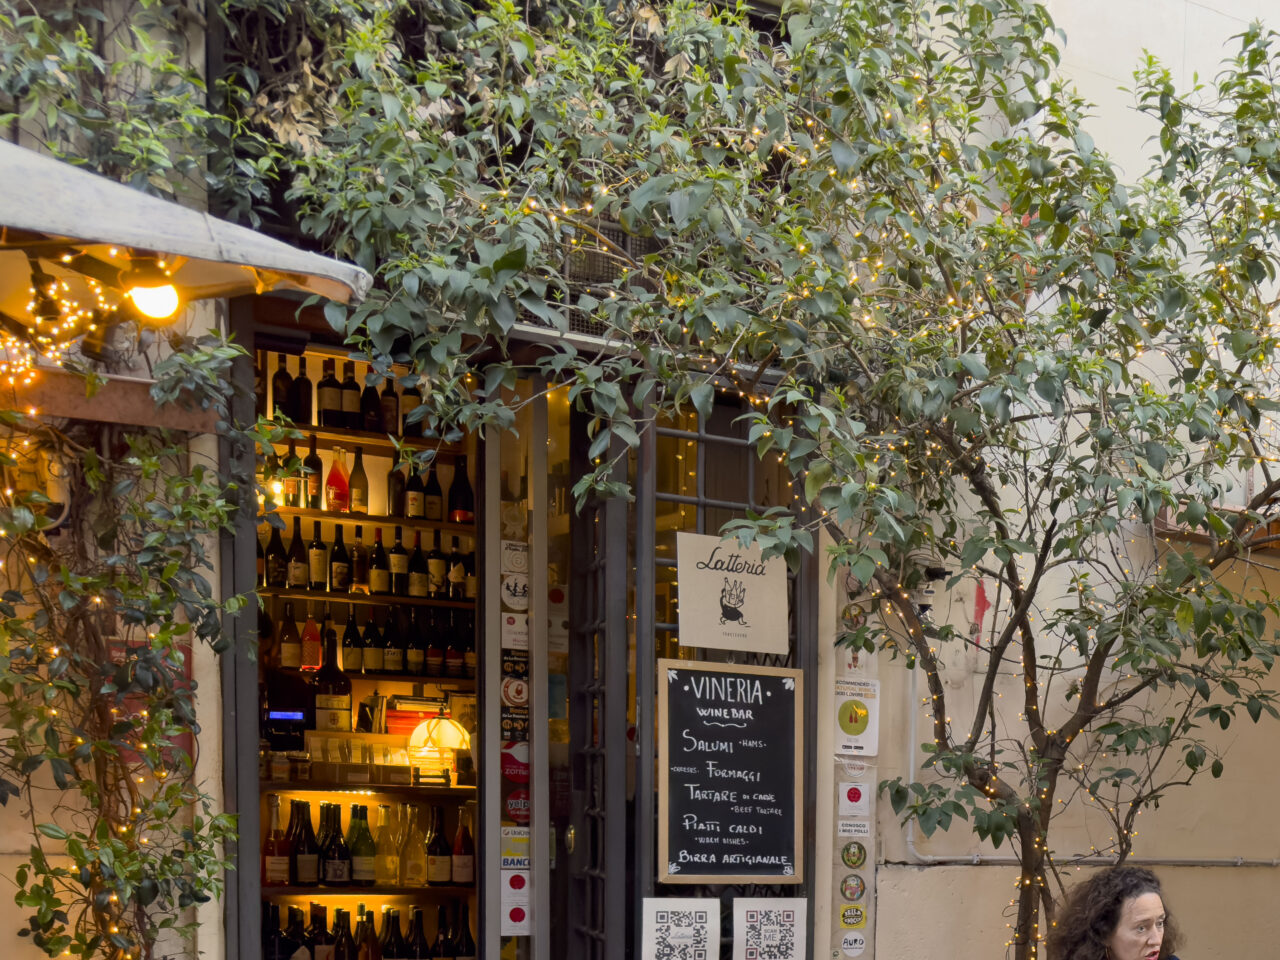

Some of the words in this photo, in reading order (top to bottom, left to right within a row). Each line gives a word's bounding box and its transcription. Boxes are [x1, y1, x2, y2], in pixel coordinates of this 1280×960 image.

[696, 547, 766, 576] Latteria
[691, 676, 763, 705] VINERIA
[697, 708, 730, 719] WINE
[731, 708, 754, 720] BAR
[683, 729, 734, 753] SALUMI
[706, 761, 760, 781] FORMAGGI
[684, 784, 737, 802] TARTARE
[753, 793, 777, 802] CARNE
[508, 800, 529, 809] yelp
[683, 814, 721, 832] PIATTI
[729, 825, 763, 834] CALDI
[678, 850, 717, 863] BIRRA
[722, 854, 792, 865] ARTIGIANALE
[764, 934, 777, 942] ME
[843, 938, 864, 946] AURO
